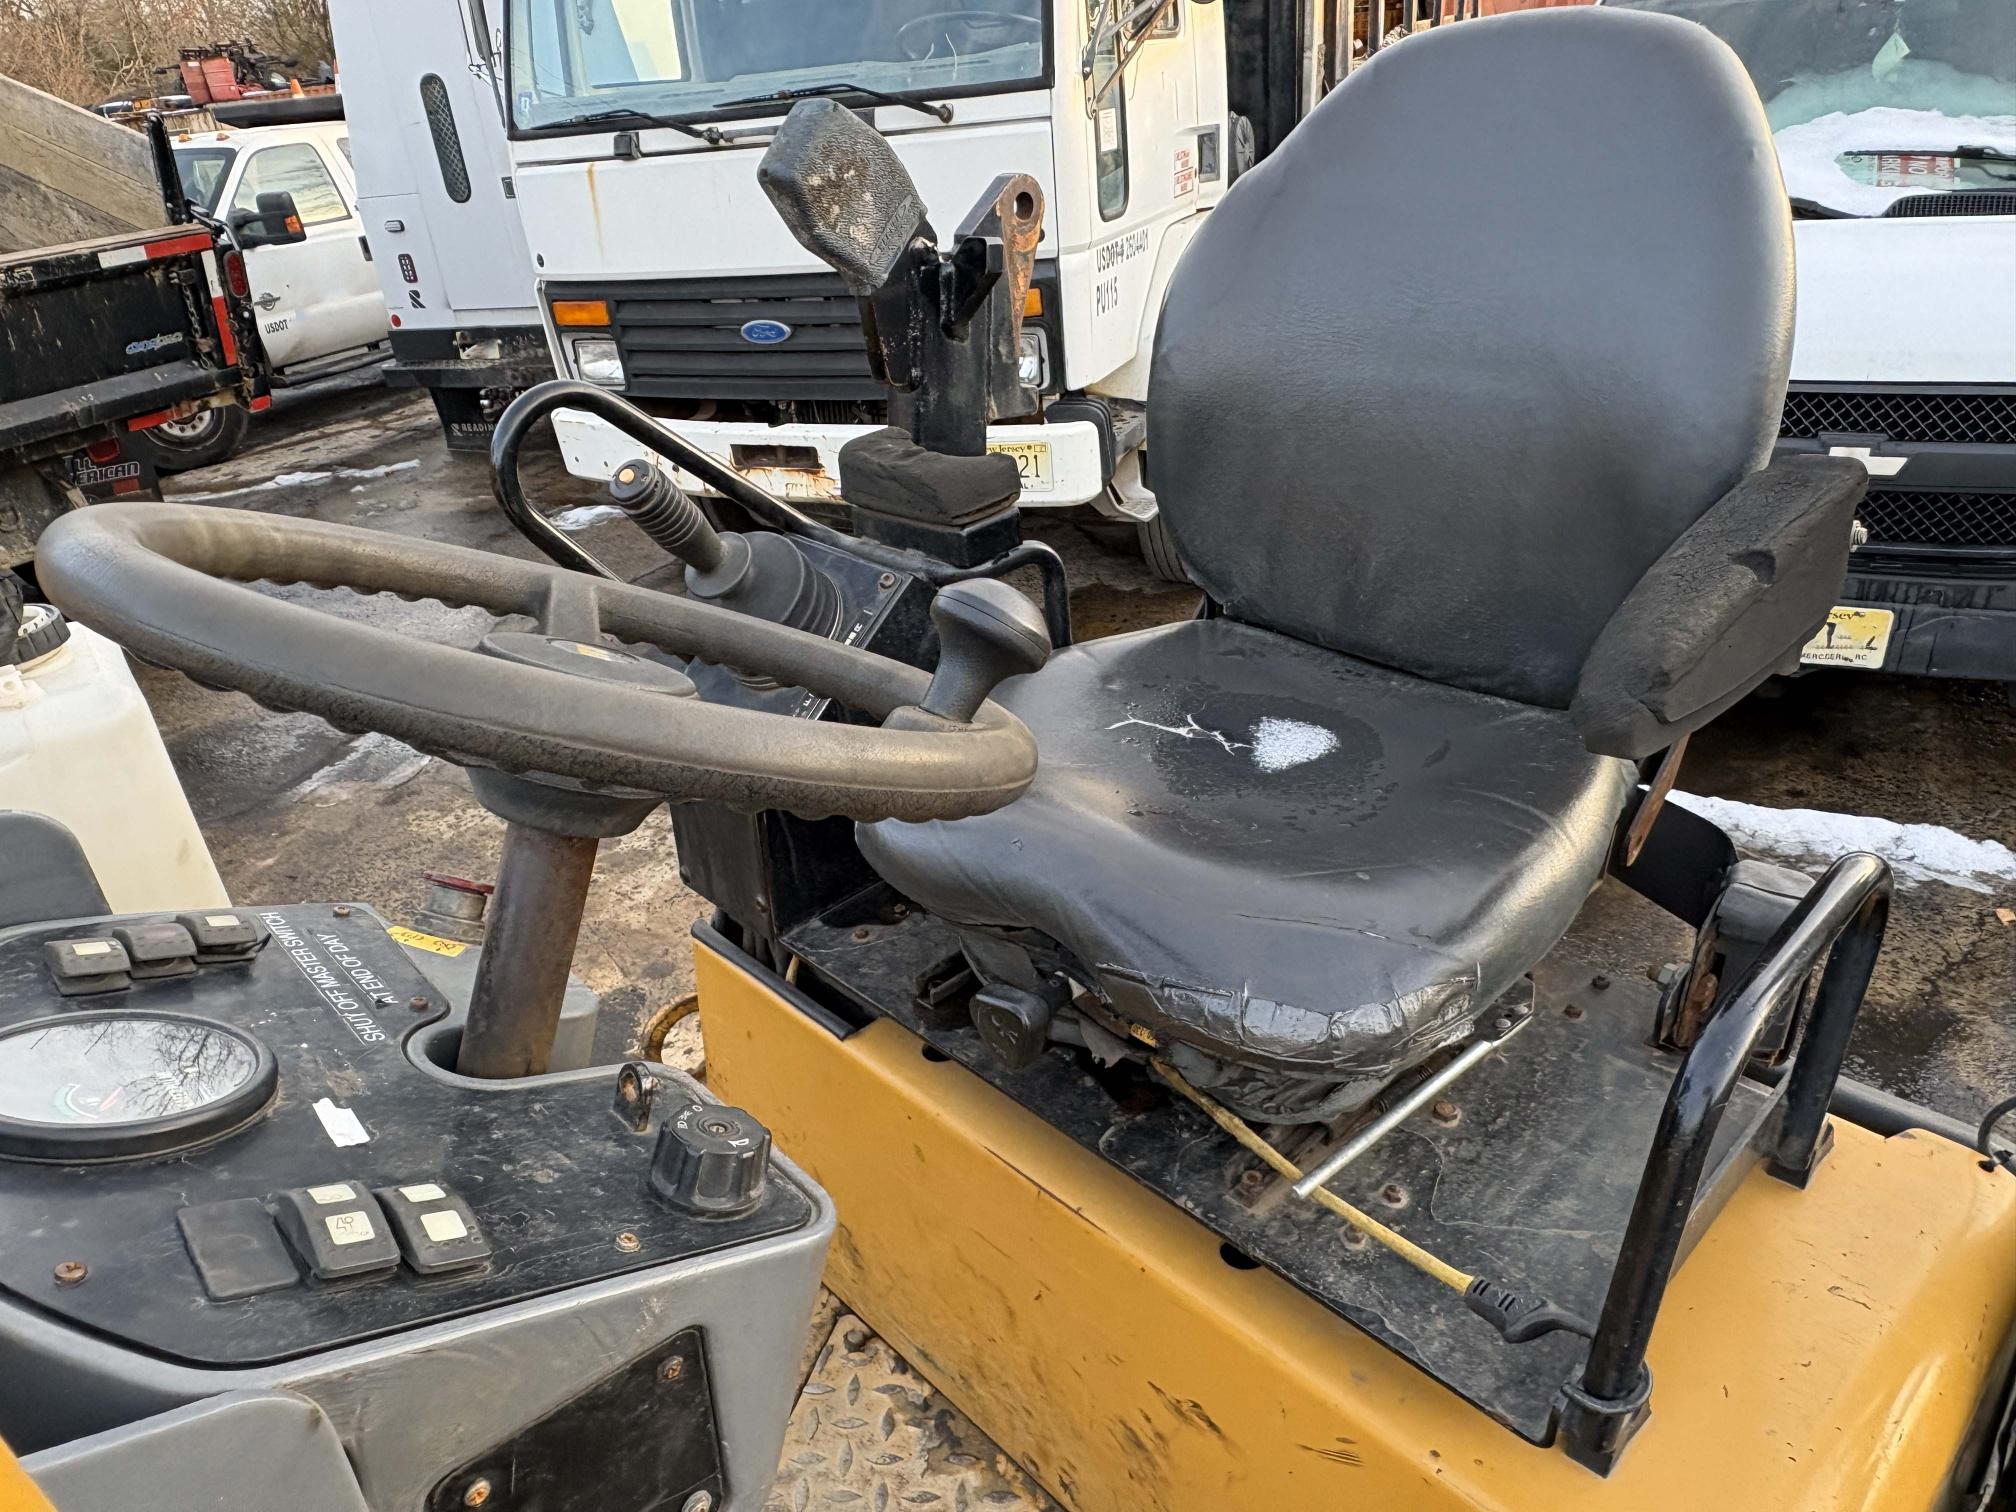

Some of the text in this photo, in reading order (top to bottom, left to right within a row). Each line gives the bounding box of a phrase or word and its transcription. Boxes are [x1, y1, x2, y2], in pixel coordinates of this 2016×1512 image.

[1096, 276, 1118, 317] PU115
[264, 319, 289, 334] USDOT
[461, 423, 499, 432] READIN
[259, 911, 386, 1042] SHUT OFF MASTER SWITCH
[316, 933, 399, 1004] AT END OF DAY
